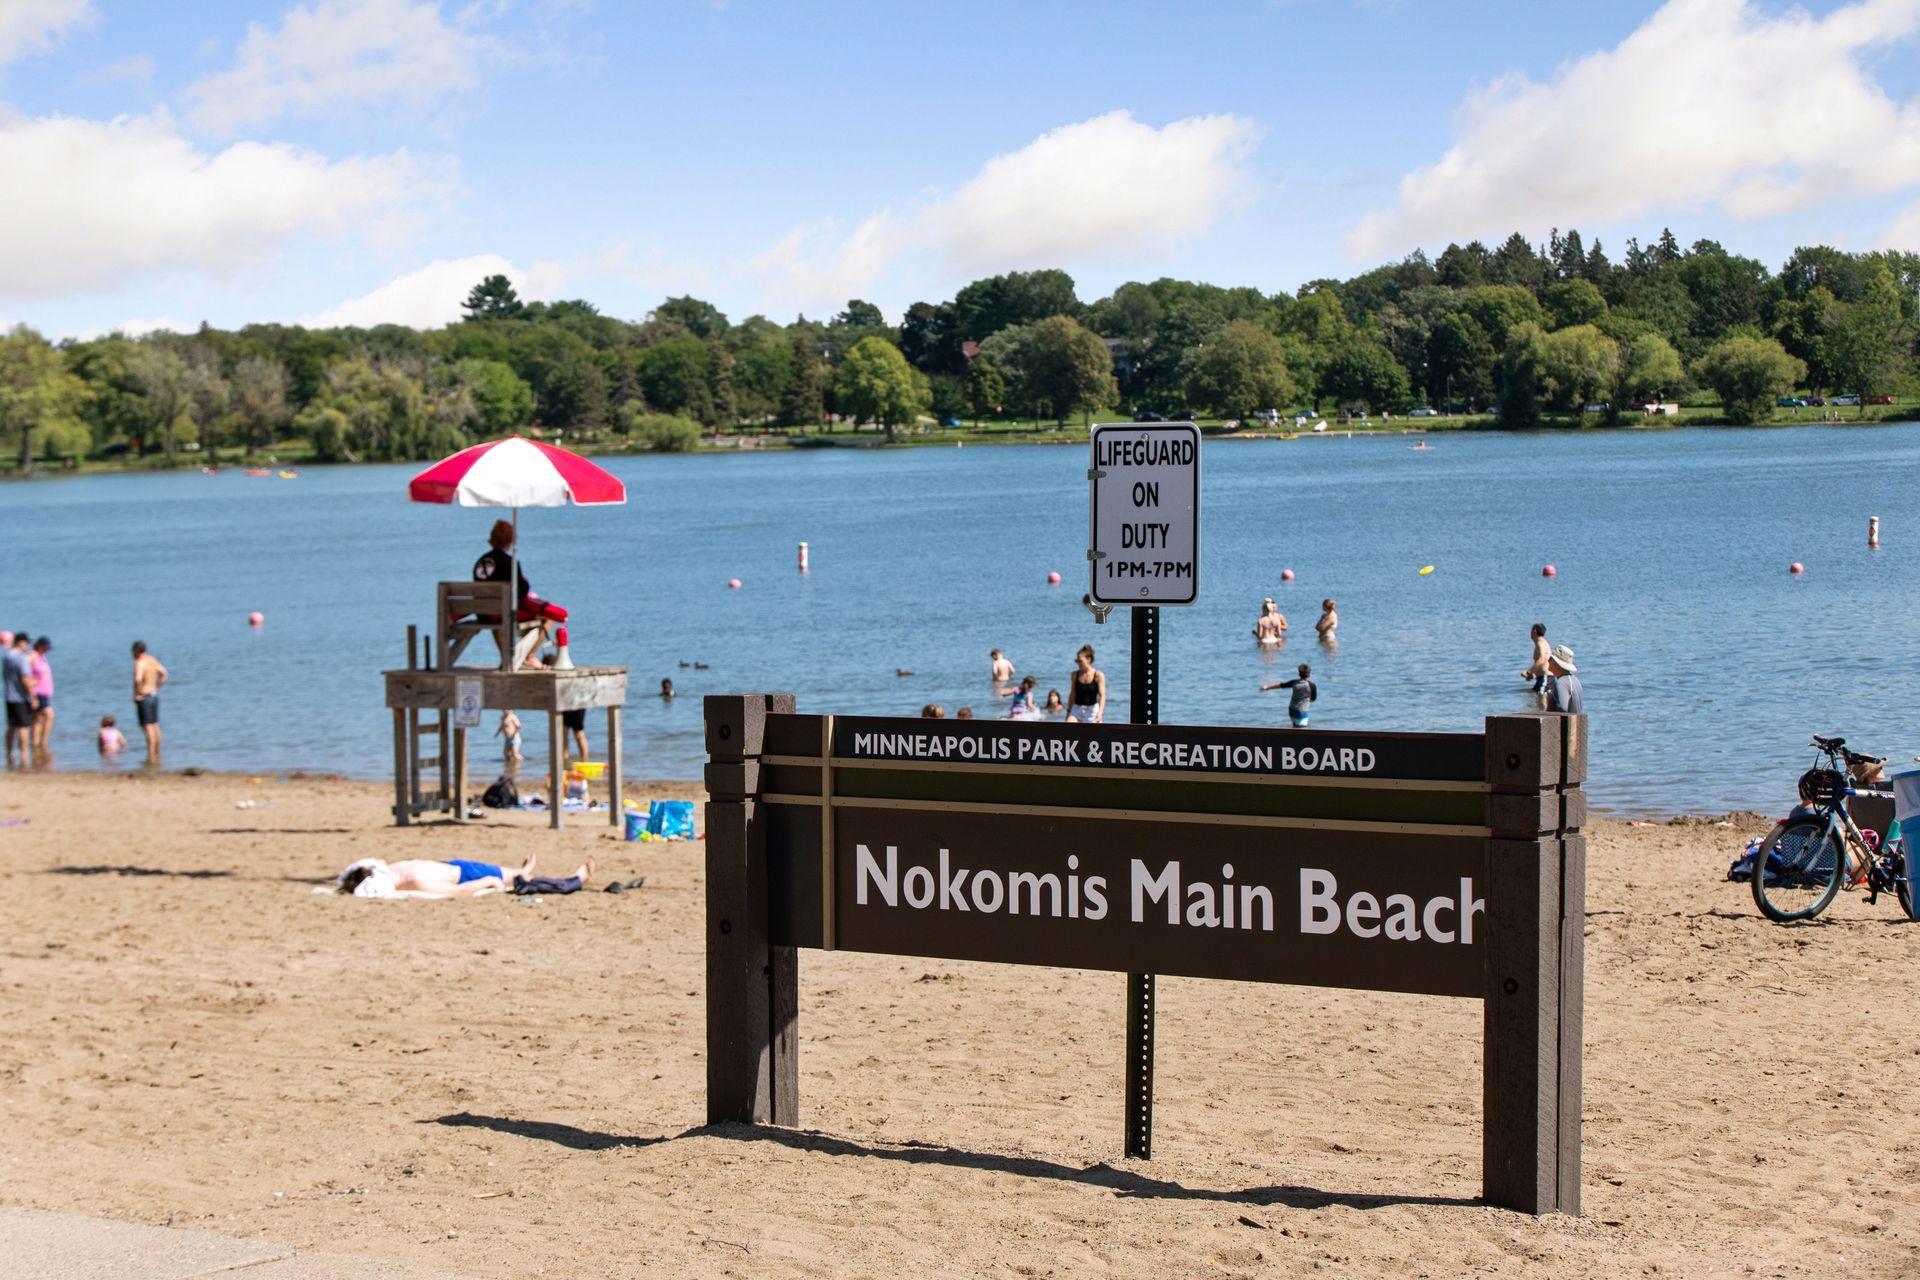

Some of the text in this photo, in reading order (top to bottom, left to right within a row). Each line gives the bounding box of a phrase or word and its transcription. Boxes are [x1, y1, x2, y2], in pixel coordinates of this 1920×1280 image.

[1098, 440, 1194, 466] LIFEGUARD
[1132, 482, 1159, 507] ON
[1122, 523, 1170, 548] DUTY
[1105, 561, 1192, 578] 1PM-7PM
[854, 733, 1376, 772] MINNEAPOLIS PARK & RECREATION BOARD
[856, 844, 1109, 920] Nokomis
[1131, 858, 1274, 932] Main
